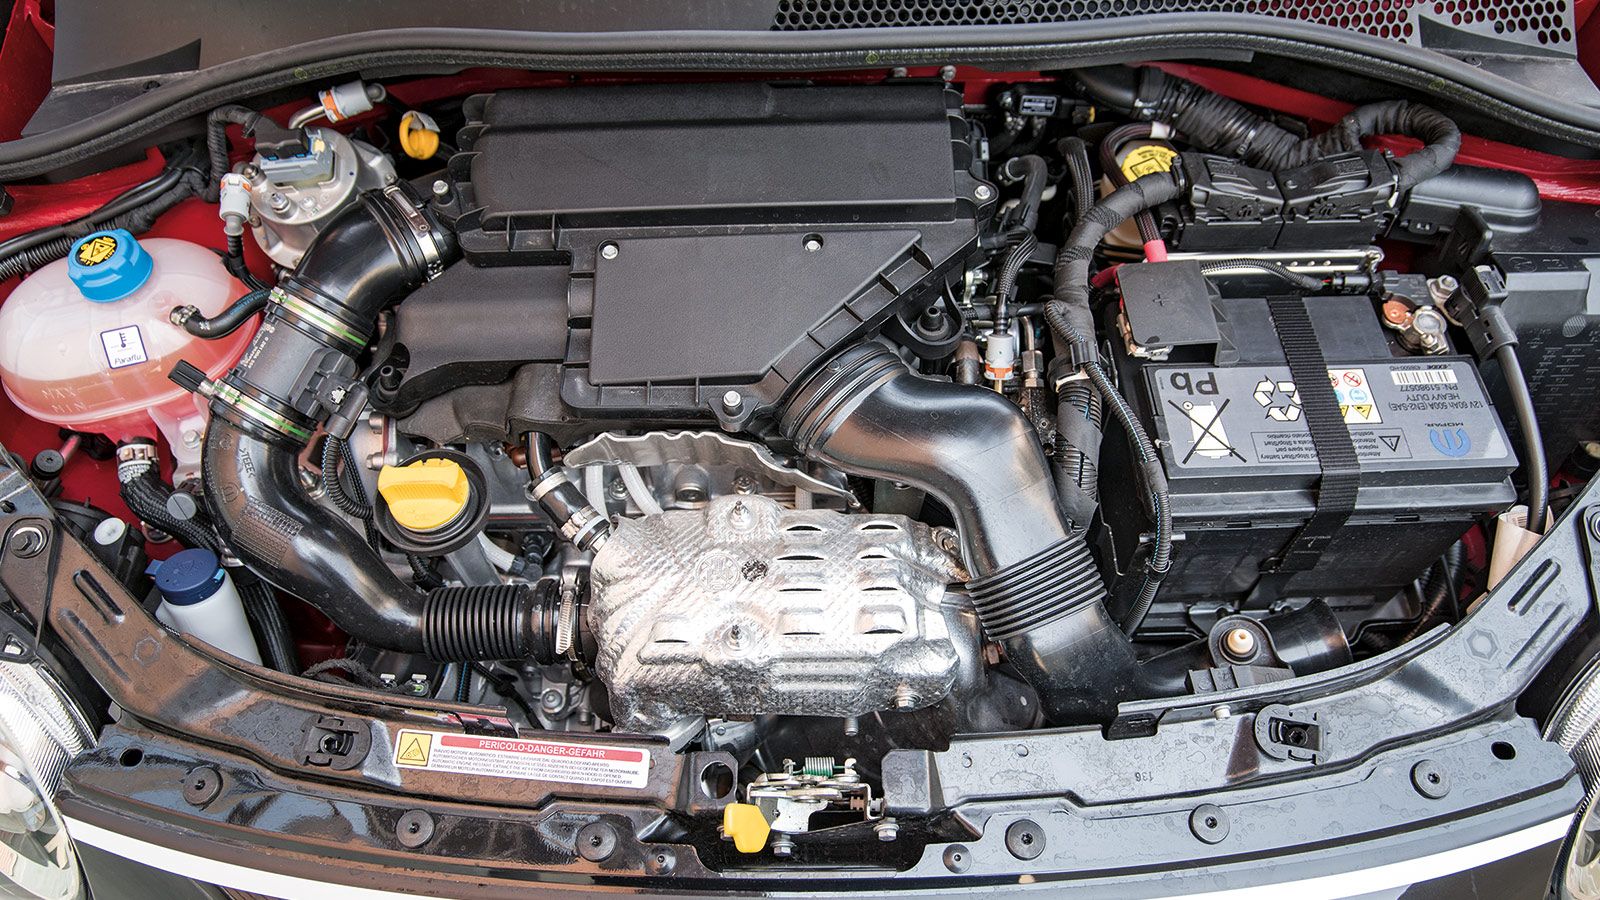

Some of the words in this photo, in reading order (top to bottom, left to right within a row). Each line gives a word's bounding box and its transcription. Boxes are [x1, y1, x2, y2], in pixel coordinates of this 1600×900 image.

[1170, 372, 1219, 396] Pb
[1406, 393, 1430, 401] DUTY
[1428, 402, 1448, 410] 500A
[479, 740, 606, 758] PERICOLO-DANGER-GEFAHR
[1135, 772, 1154, 782] 136
